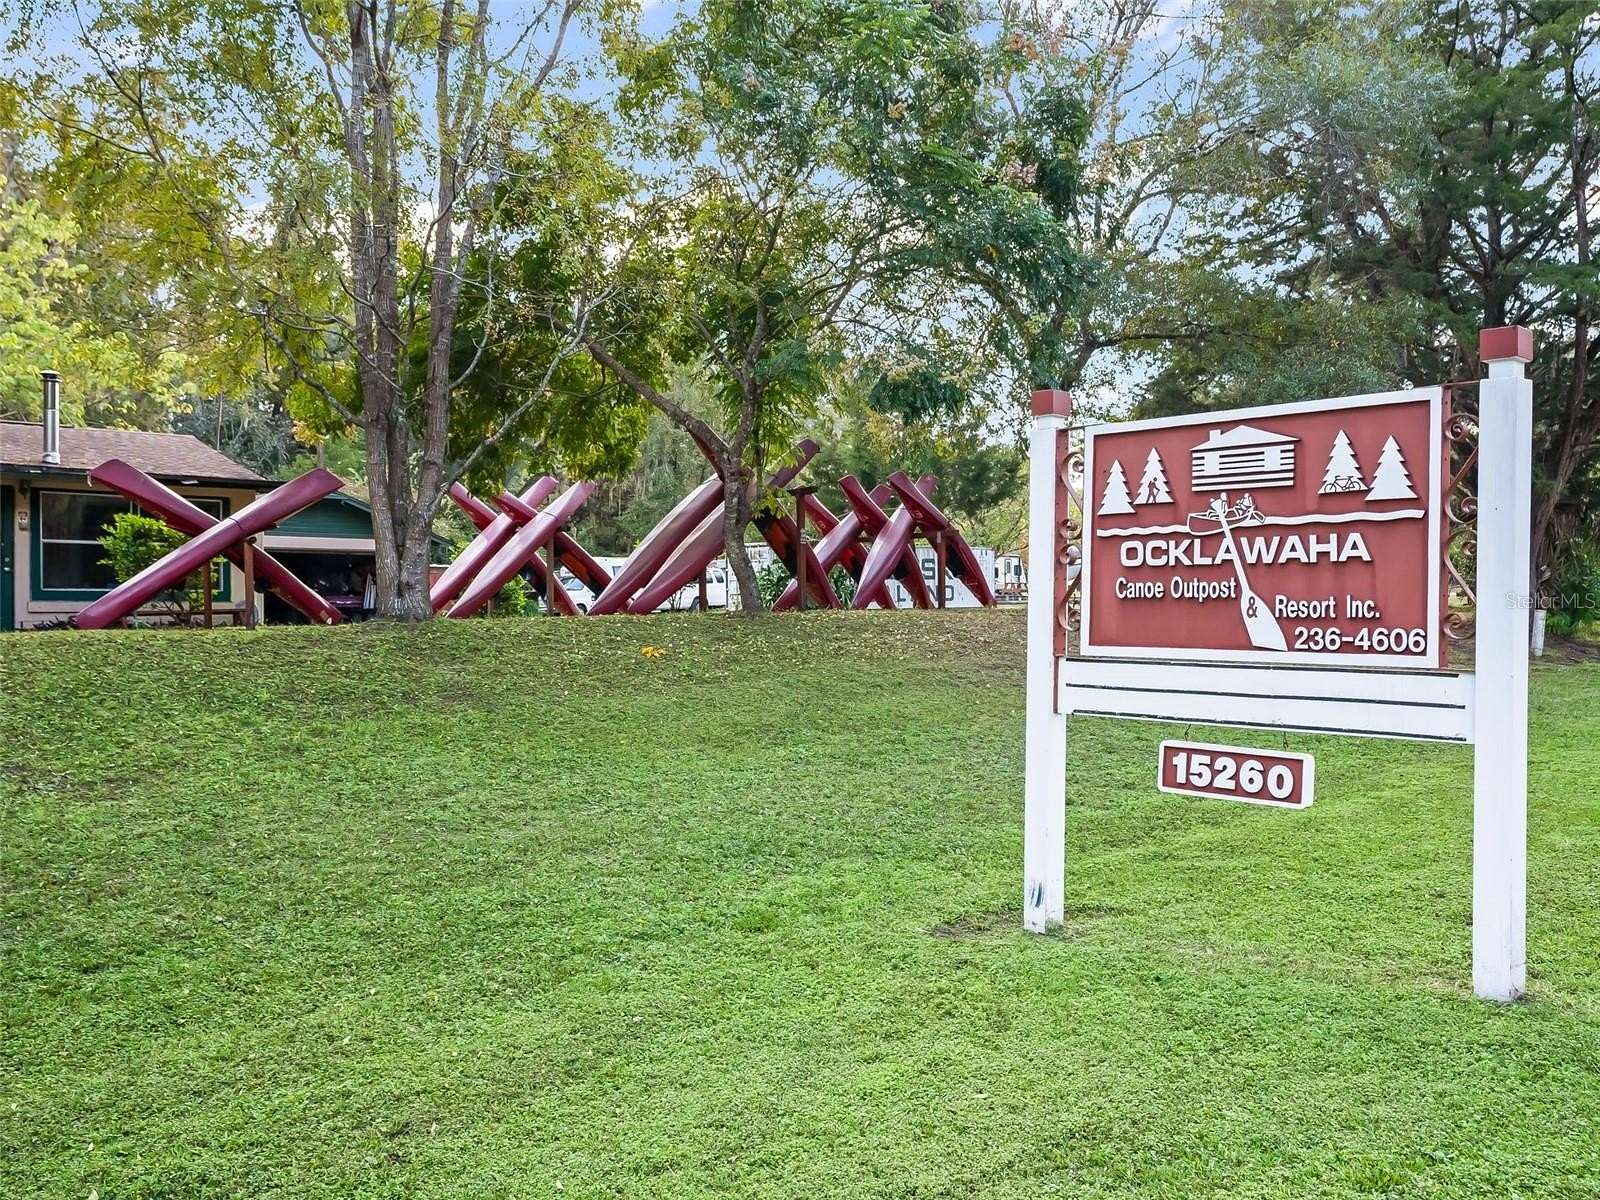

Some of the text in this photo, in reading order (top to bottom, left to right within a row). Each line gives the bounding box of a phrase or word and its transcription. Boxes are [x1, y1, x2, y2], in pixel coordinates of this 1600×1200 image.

[1120, 532, 1372, 568] OCKLAWAHA
[896, 584, 955, 602] LND
[1115, 575, 1237, 602] Canoe Outpost
[1246, 594, 1380, 619] & Resort Inc.
[1294, 626, 1426, 653] 236-4606
[1172, 752, 1294, 799] 15260
